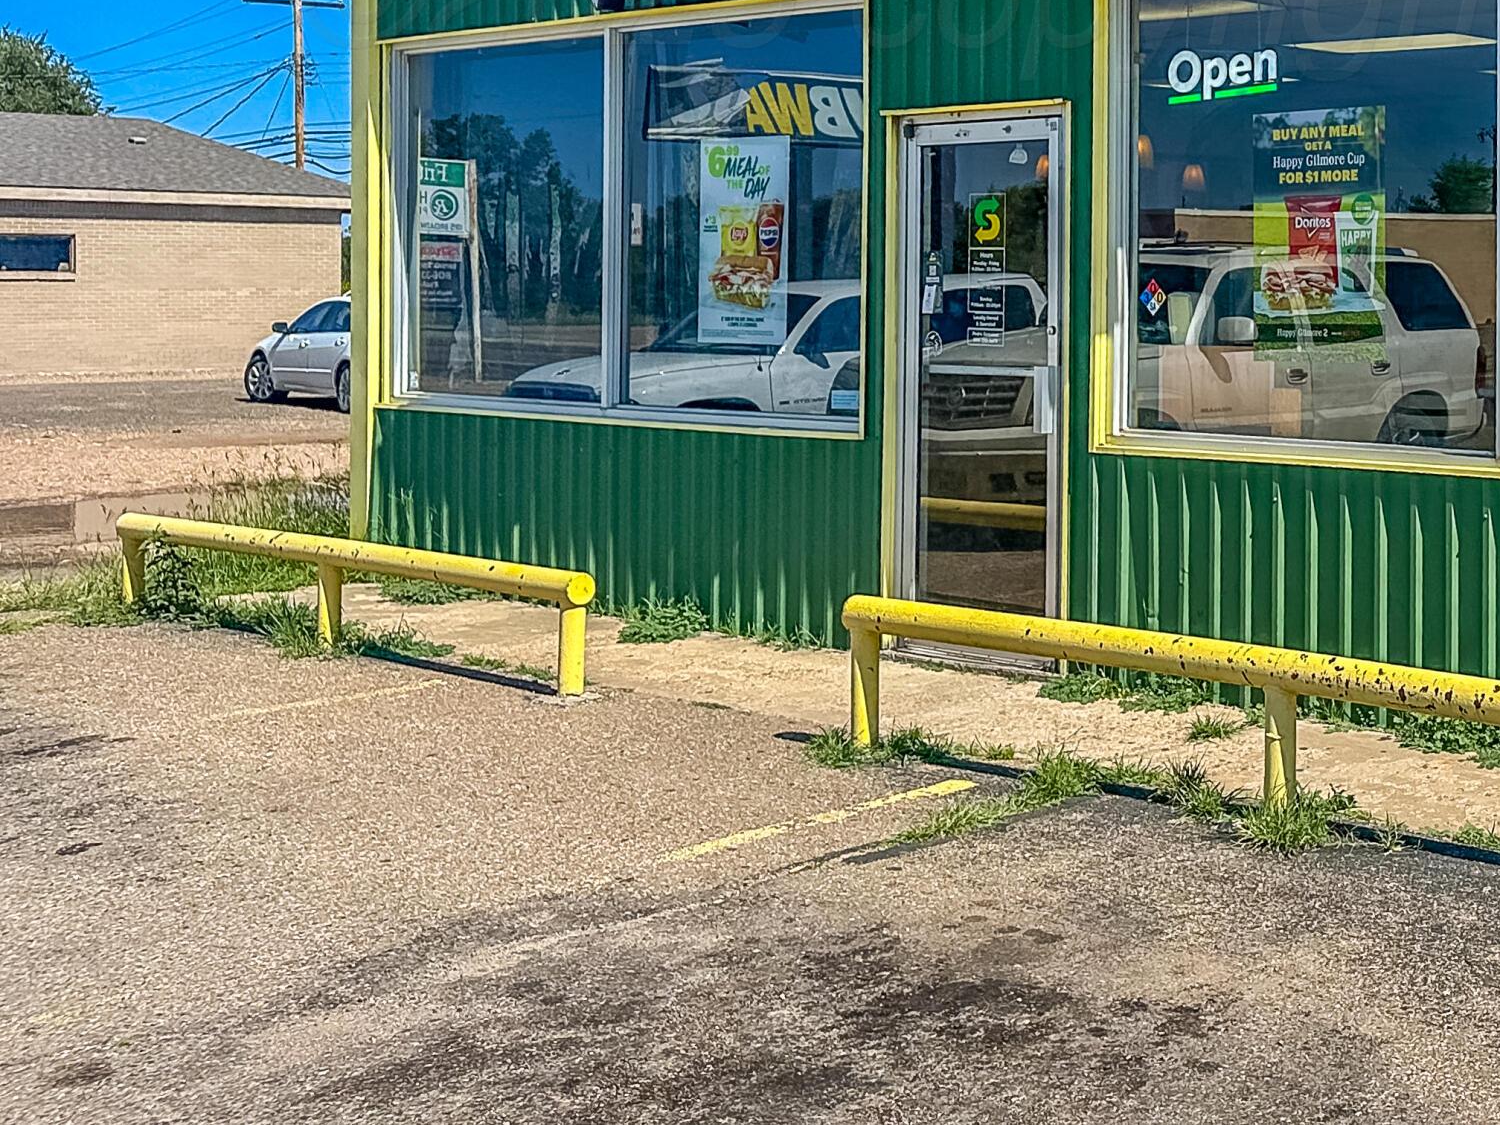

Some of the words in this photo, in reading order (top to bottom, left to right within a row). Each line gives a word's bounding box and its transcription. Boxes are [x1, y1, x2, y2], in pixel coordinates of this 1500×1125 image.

[1167, 48, 1278, 101] Open
[1272, 127, 1298, 141] BUY
[1300, 125, 1326, 140] ANY
[1329, 124, 1365, 137] MEAL
[1304, 141, 1323, 151] GET
[1323, 140, 1332, 150] A
[723, 155, 759, 178] MEAL
[759, 165, 771, 175] OF
[1273, 156, 1304, 169] Happy
[1306, 154, 1345, 167] Gilmore
[1347, 152, 1366, 166] Cup
[1279, 172, 1303, 184] FOR
[1305, 170, 1319, 185] $1
[1320, 169, 1359, 182] MORE
[727, 179, 744, 189] THE
[743, 176, 771, 200] DAY
[1295, 217, 1331, 228] Doritos
[1341, 230, 1372, 247] HAPPY
